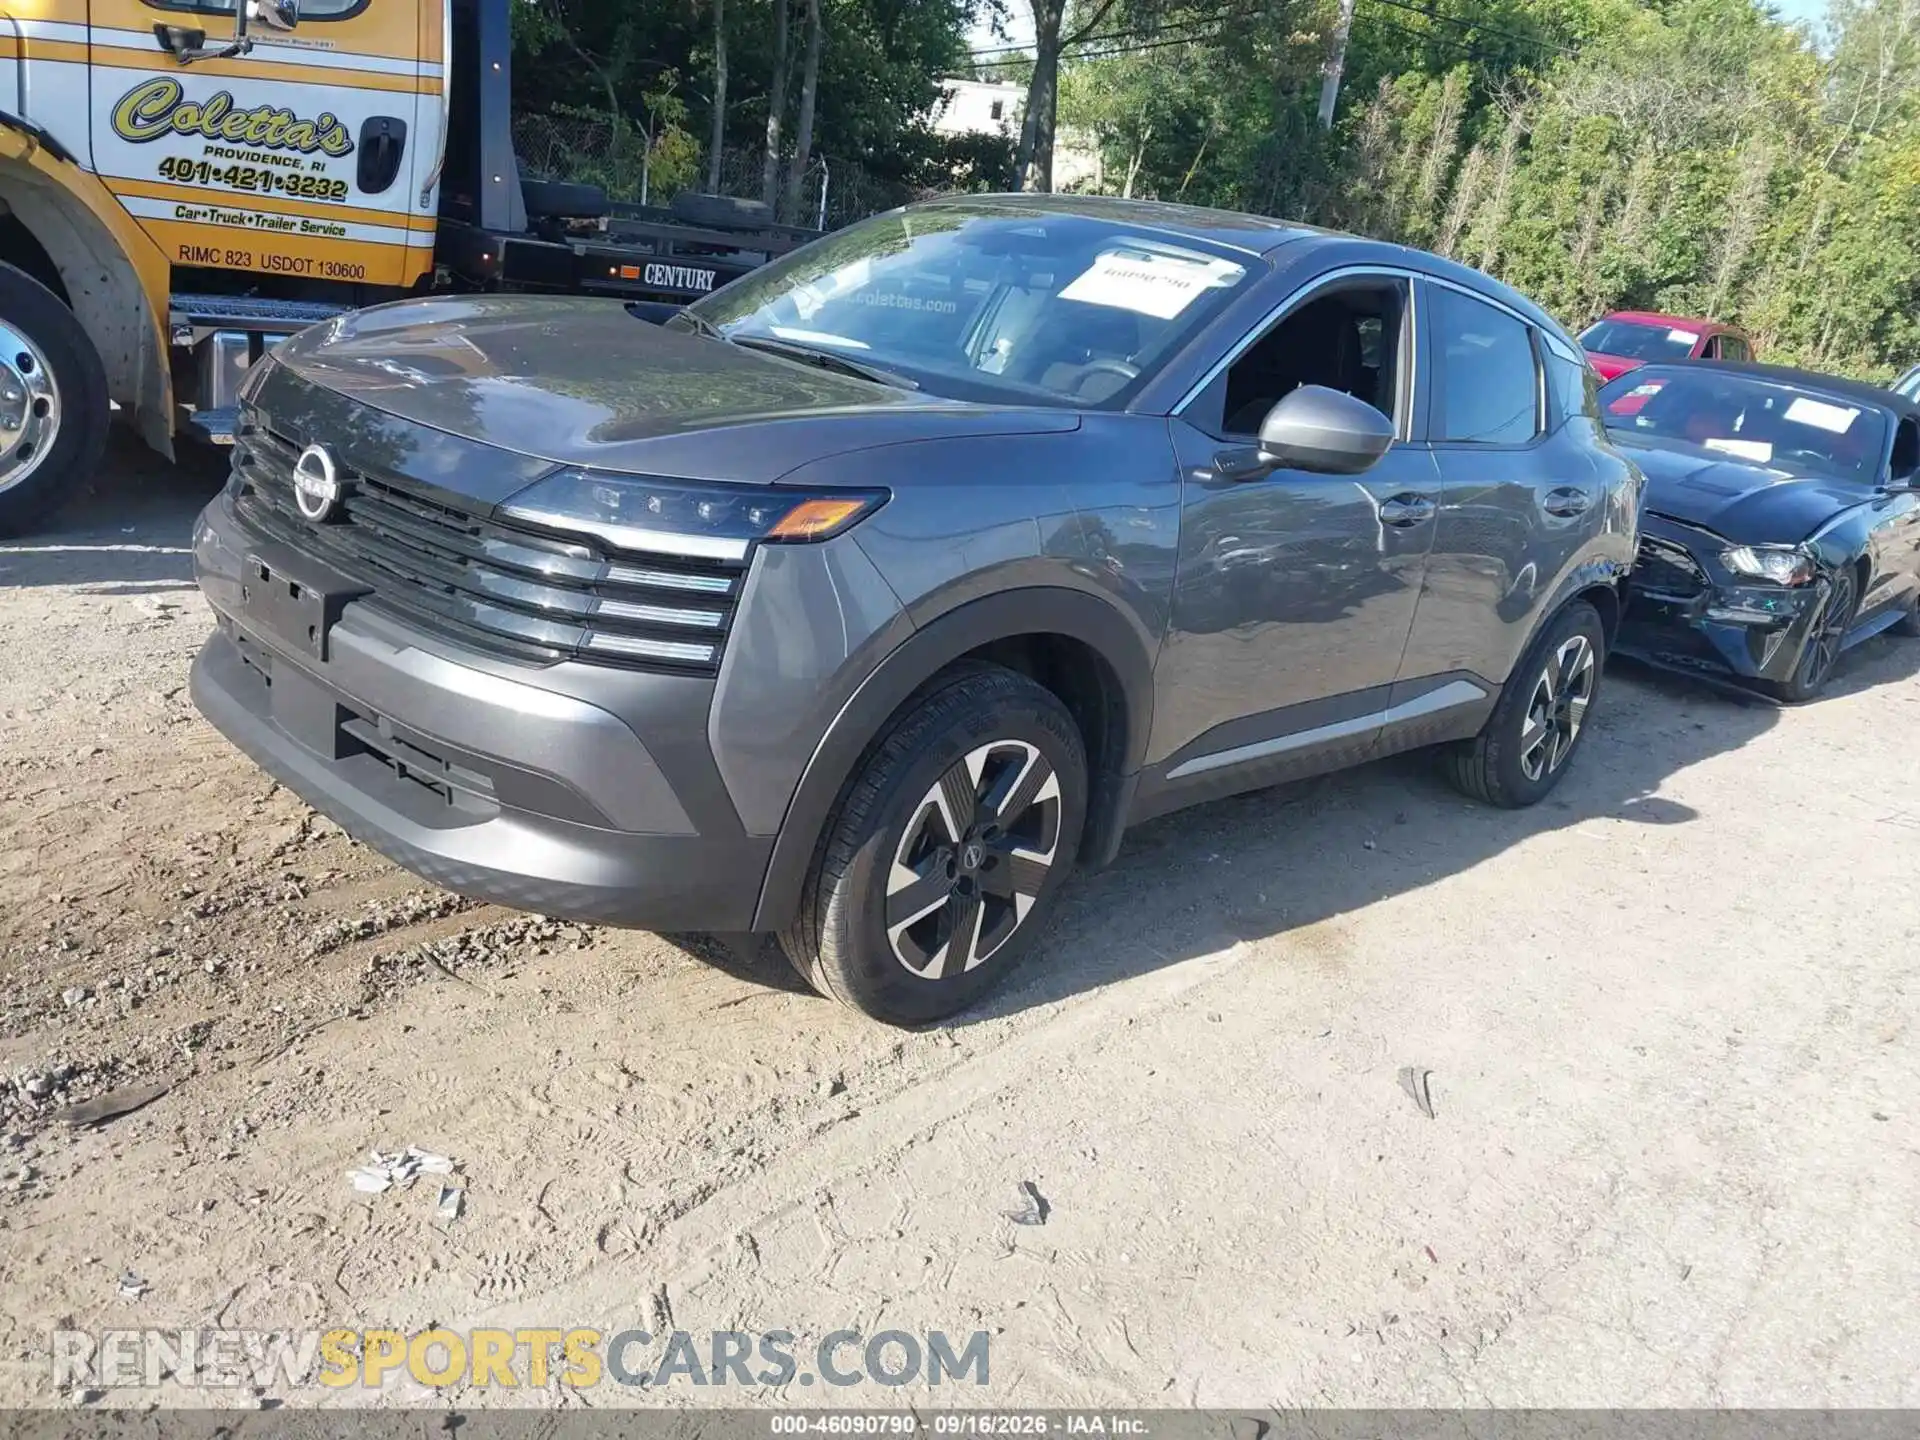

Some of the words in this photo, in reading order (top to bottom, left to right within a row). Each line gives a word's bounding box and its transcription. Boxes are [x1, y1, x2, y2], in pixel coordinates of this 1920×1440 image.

[111, 76, 354, 157] Coletta's
[203, 144, 304, 171] PROVIDENCE,
[310, 161, 327, 173] RI
[300, 219, 347, 237] Service
[179, 243, 221, 264] RIMC
[225, 250, 253, 267] 823
[261, 254, 314, 274] USDOT
[317, 260, 366, 280] 130600
[644, 263, 717, 292] CENTURY
